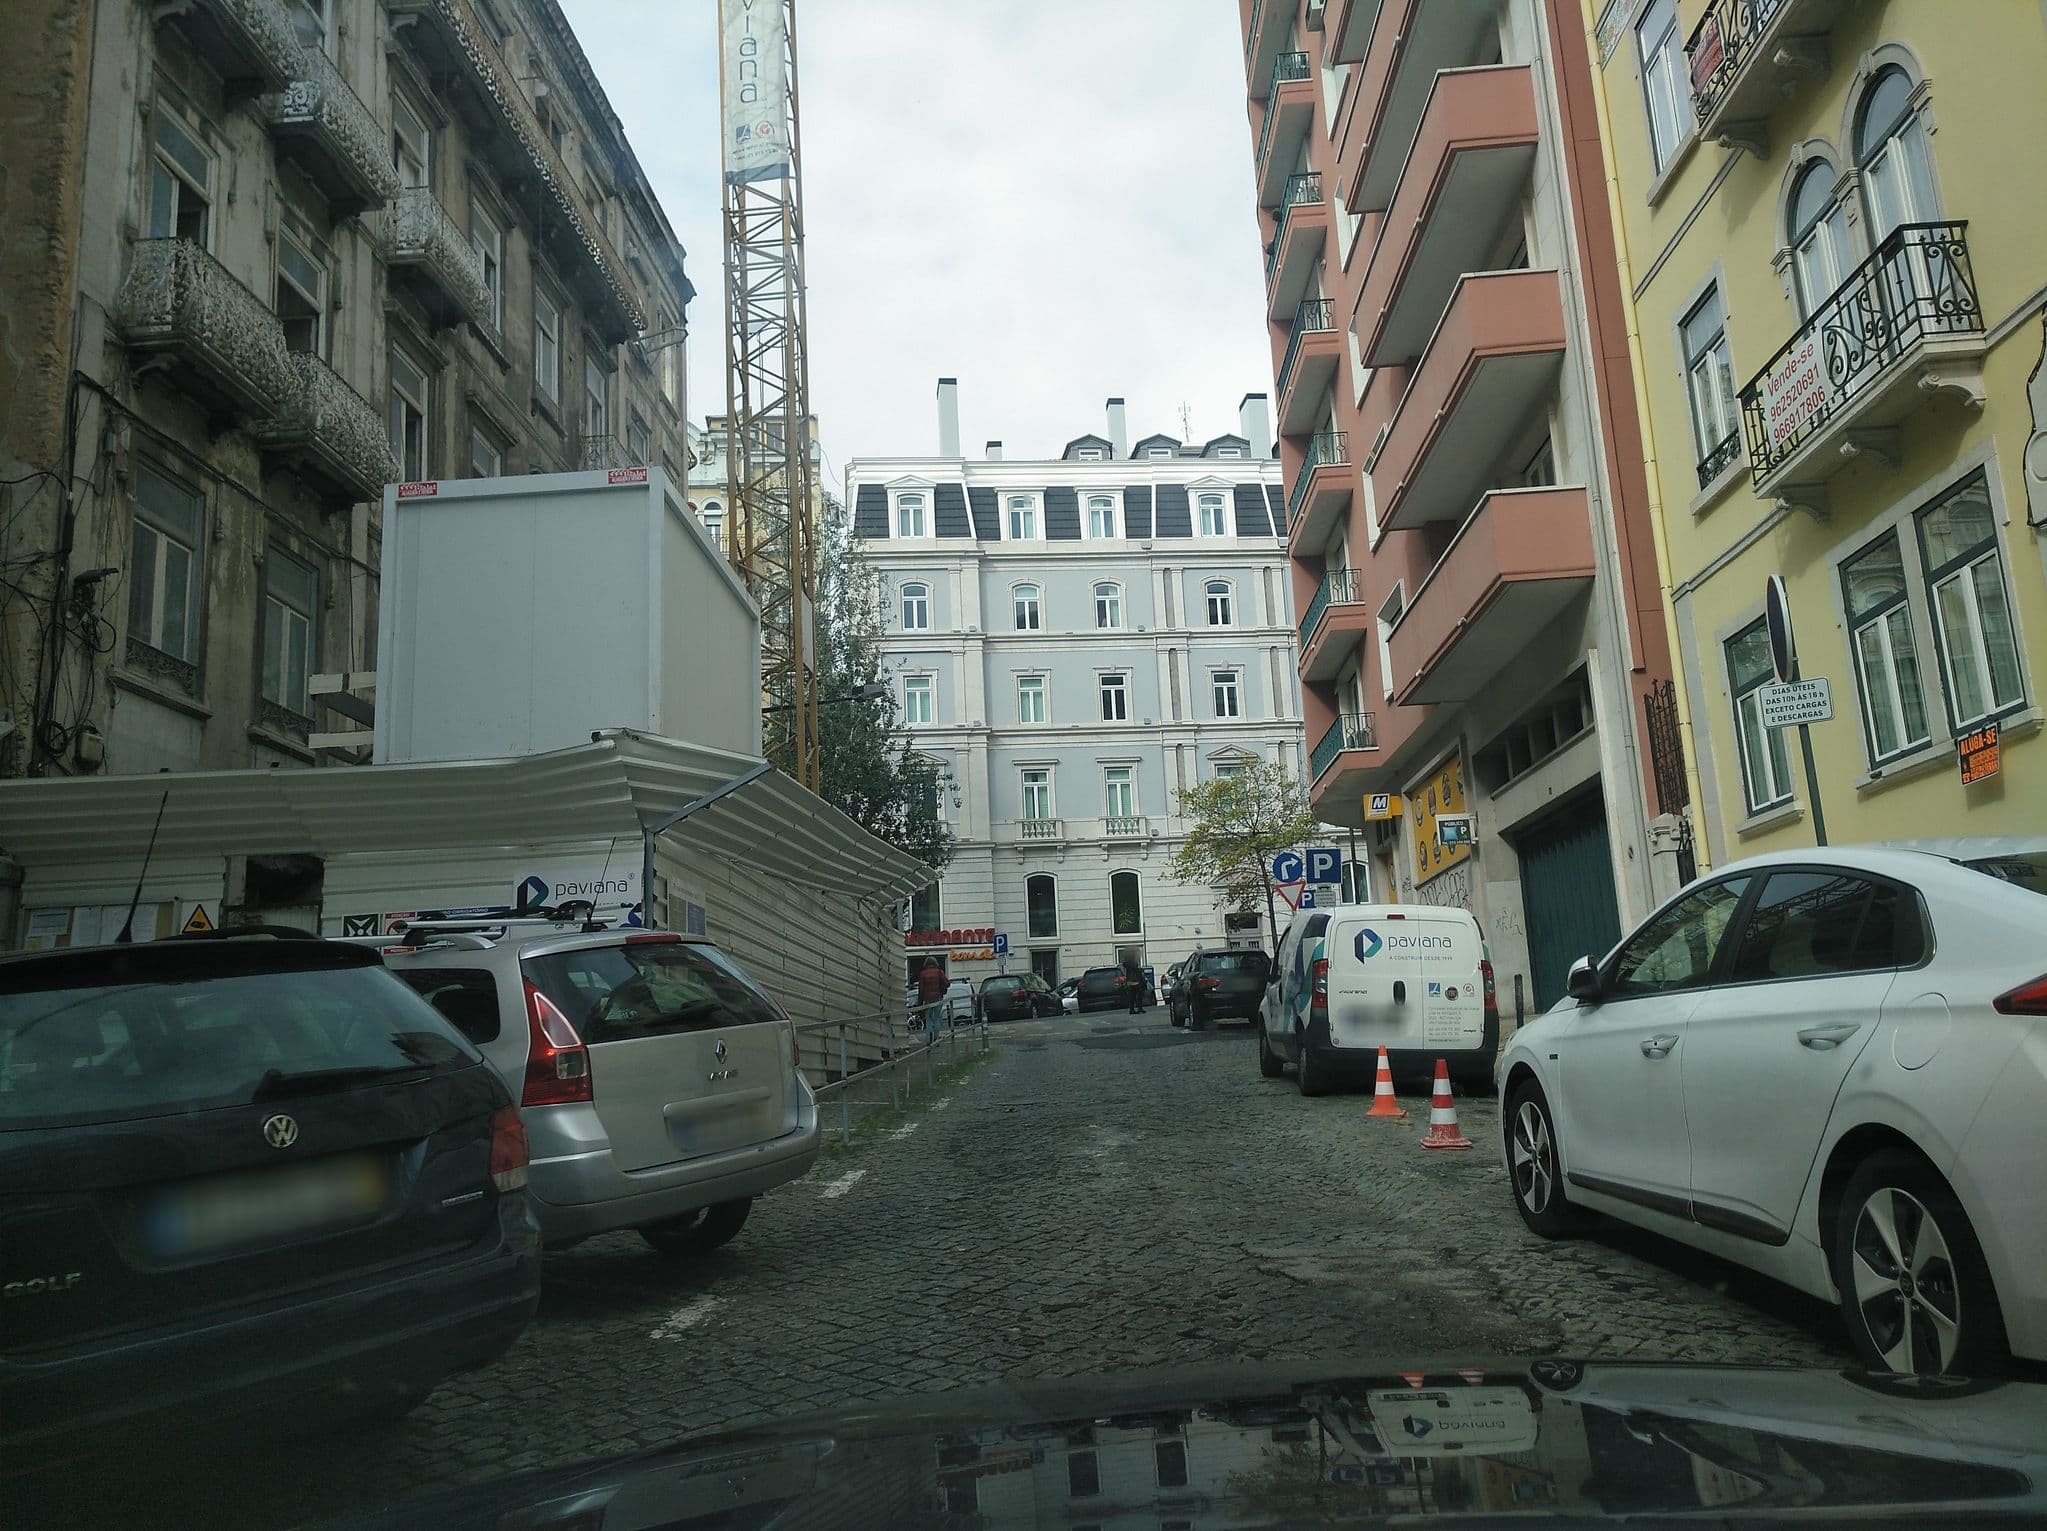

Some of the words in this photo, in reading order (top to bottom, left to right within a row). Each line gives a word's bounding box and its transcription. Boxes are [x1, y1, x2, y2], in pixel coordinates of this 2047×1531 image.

[1767, 343, 1814, 396] Vende-se
[1770, 362, 1820, 422] 962520691
[1773, 385, 1826, 444] 966917806
[1772, 686, 1791, 695] DIAS
[1765, 704, 1795, 714] EXCETO
[1796, 700, 1827, 710] CARGAS
[1766, 697, 1781, 705] DAS
[1778, 710, 1823, 721] DESCARGAS
[1960, 727, 1997, 756] ALUGA-SE
[1373, 796, 1387, 809] M
[1313, 853, 1333, 879] P
[555, 880, 628, 900] paviana
[1301, 892, 1312, 907] P
[996, 936, 1005, 952] P
[1388, 936, 1452, 950] paviana
